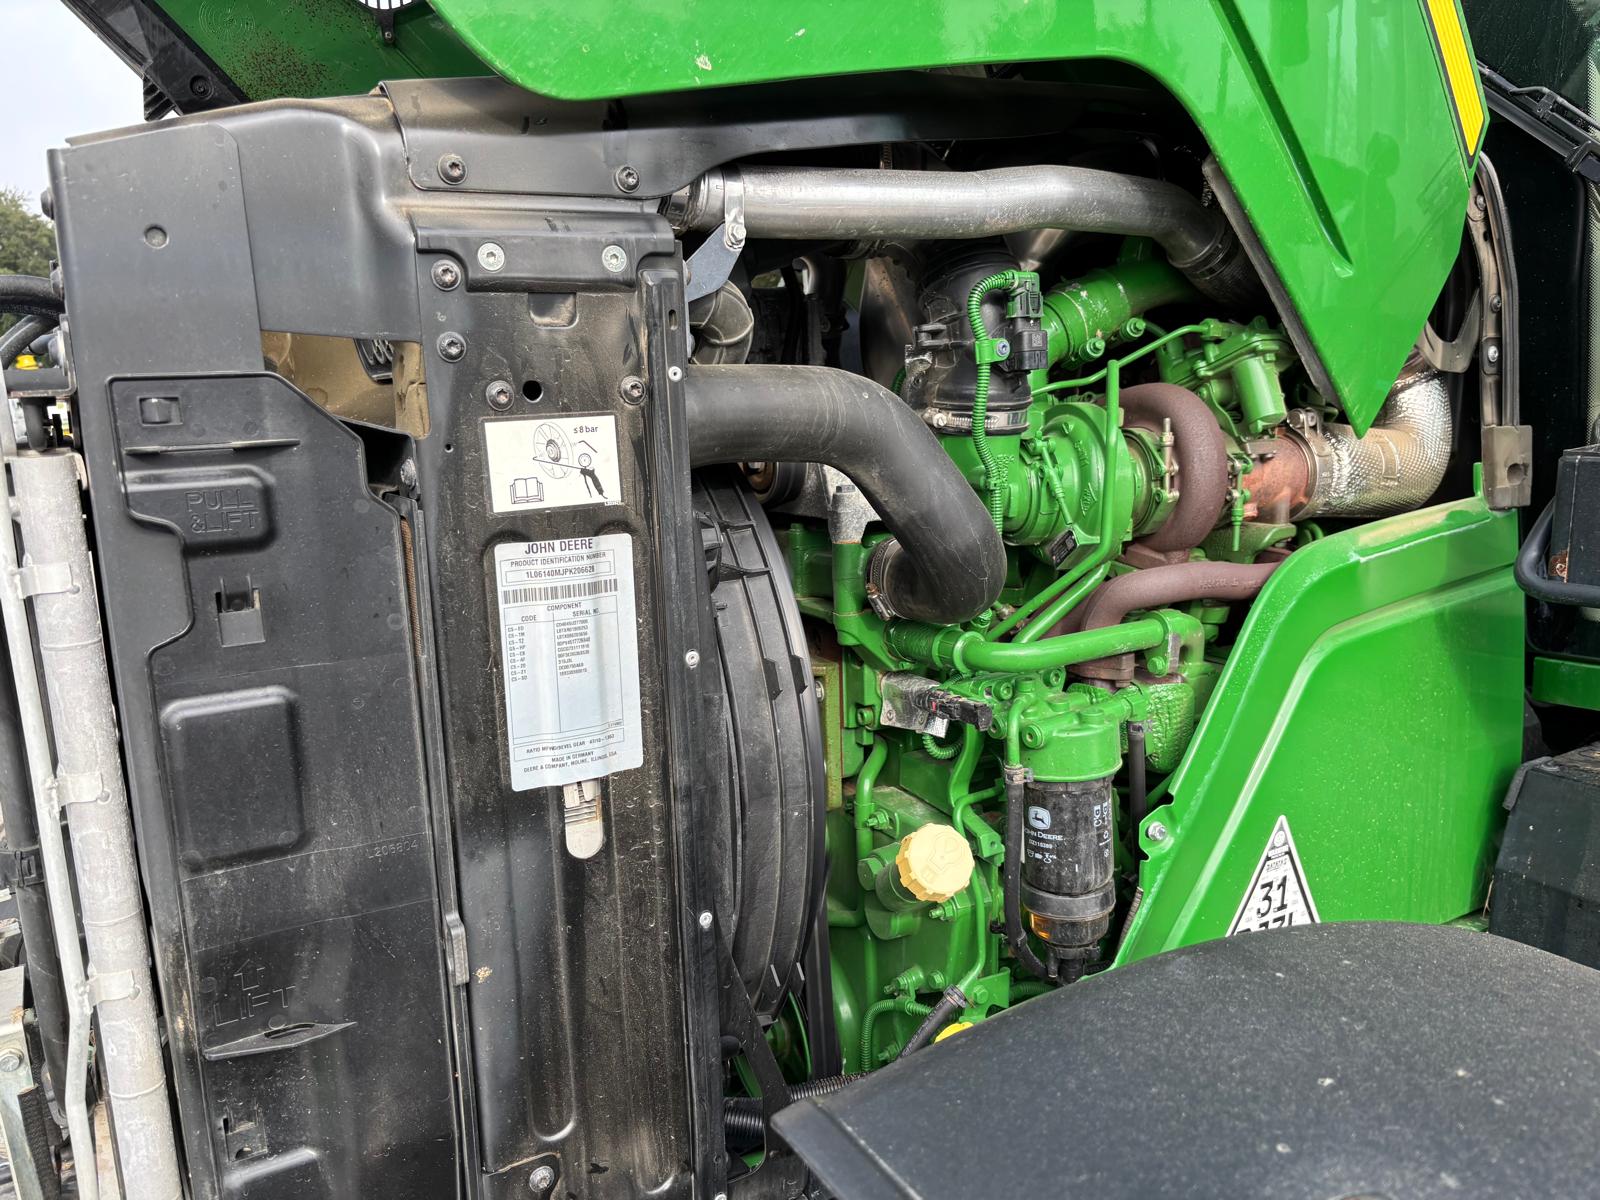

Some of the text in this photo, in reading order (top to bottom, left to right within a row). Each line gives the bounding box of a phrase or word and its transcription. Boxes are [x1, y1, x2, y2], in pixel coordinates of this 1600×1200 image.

[585, 425, 599, 433] bar
[184, 488, 255, 512] PULL
[190, 509, 260, 534] &LIFT
[525, 538, 594, 555] JOHN DEERE
[510, 551, 607, 568] PRODUCT IDENTIFICATION NUMBER
[546, 602, 582, 612] COMPONENT
[521, 614, 537, 623] CODE
[572, 609, 592, 618] SERIAL
[573, 740, 586, 748] GEAR
[572, 751, 594, 760] GERMANY
[544, 762, 570, 770] COMPANY,
[1037, 831, 1063, 841] DEERE
[1256, 874, 1288, 919] 31
[214, 985, 297, 1027] LIFT
